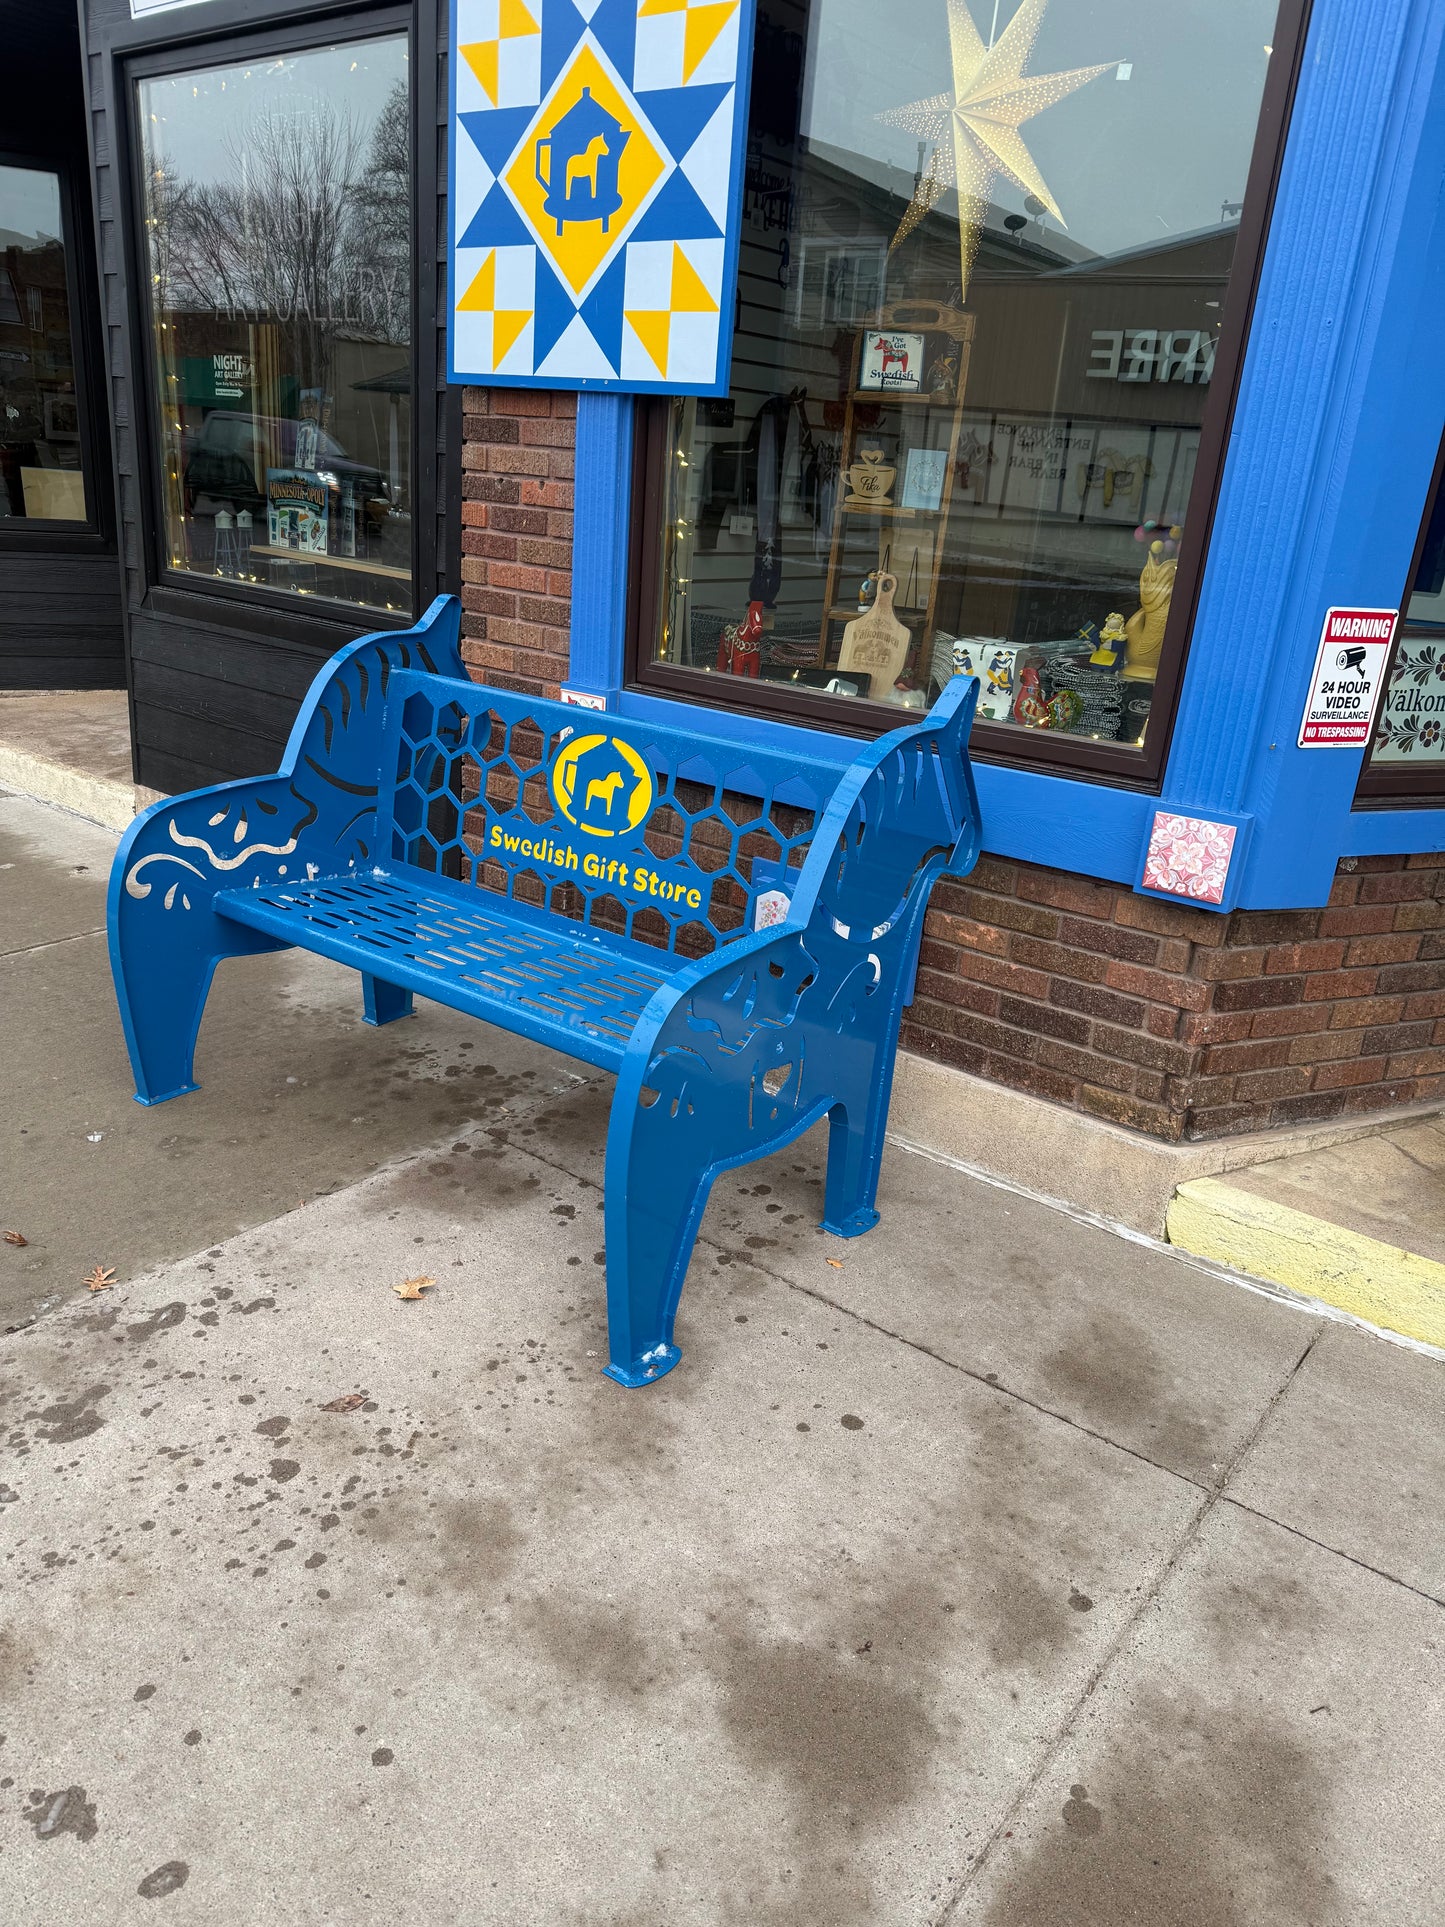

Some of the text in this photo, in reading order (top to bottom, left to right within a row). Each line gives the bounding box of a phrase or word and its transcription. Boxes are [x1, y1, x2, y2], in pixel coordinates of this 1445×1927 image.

[213, 355, 243, 370] NIGHT
[224, 371, 243, 379] GALLERY
[870, 369, 914, 381] Swedish
[861, 475, 881, 493] Fika
[1330, 617, 1391, 638] WARNING
[1321, 681, 1371, 694] 24 HOUR
[1325, 696, 1360, 709] VIDEO
[1310, 711, 1369, 720] SURVEILLANCE
[1305, 727, 1367, 738] NO TRESPASSING
[490, 825, 702, 909] Swedish Gift Store
